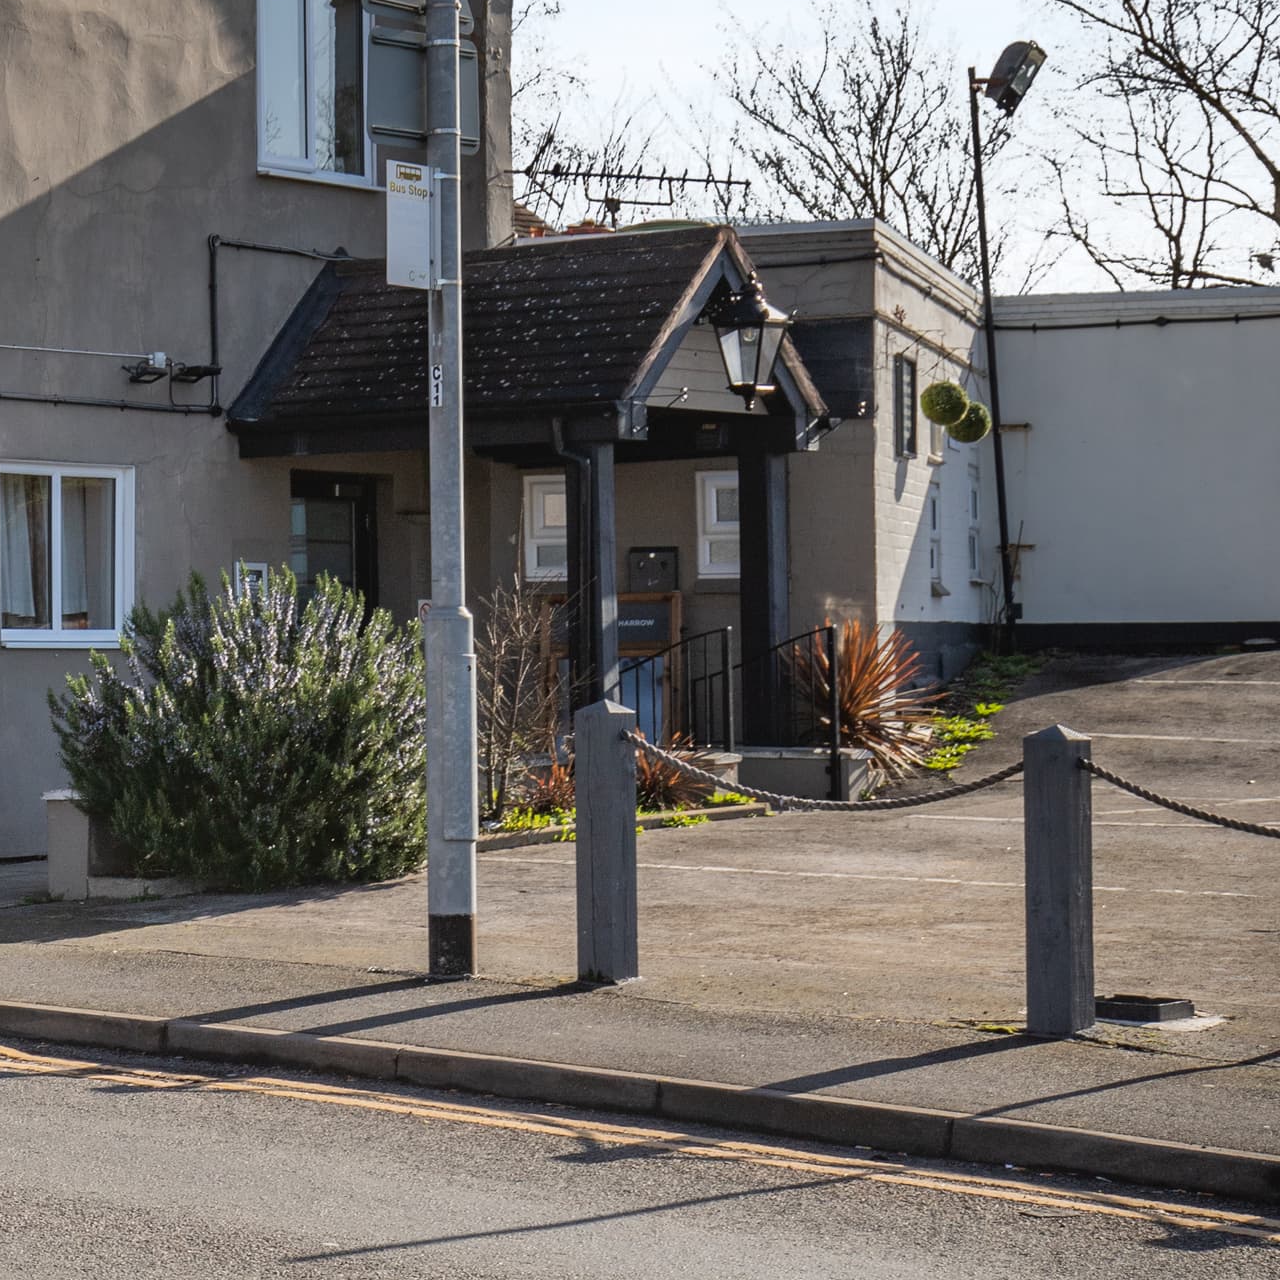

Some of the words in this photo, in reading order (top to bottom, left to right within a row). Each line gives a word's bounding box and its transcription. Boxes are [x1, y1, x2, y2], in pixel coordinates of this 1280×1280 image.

[389, 181, 407, 194] Bus
[408, 184, 428, 200] Stop
[617, 618, 655, 627] HARROW
